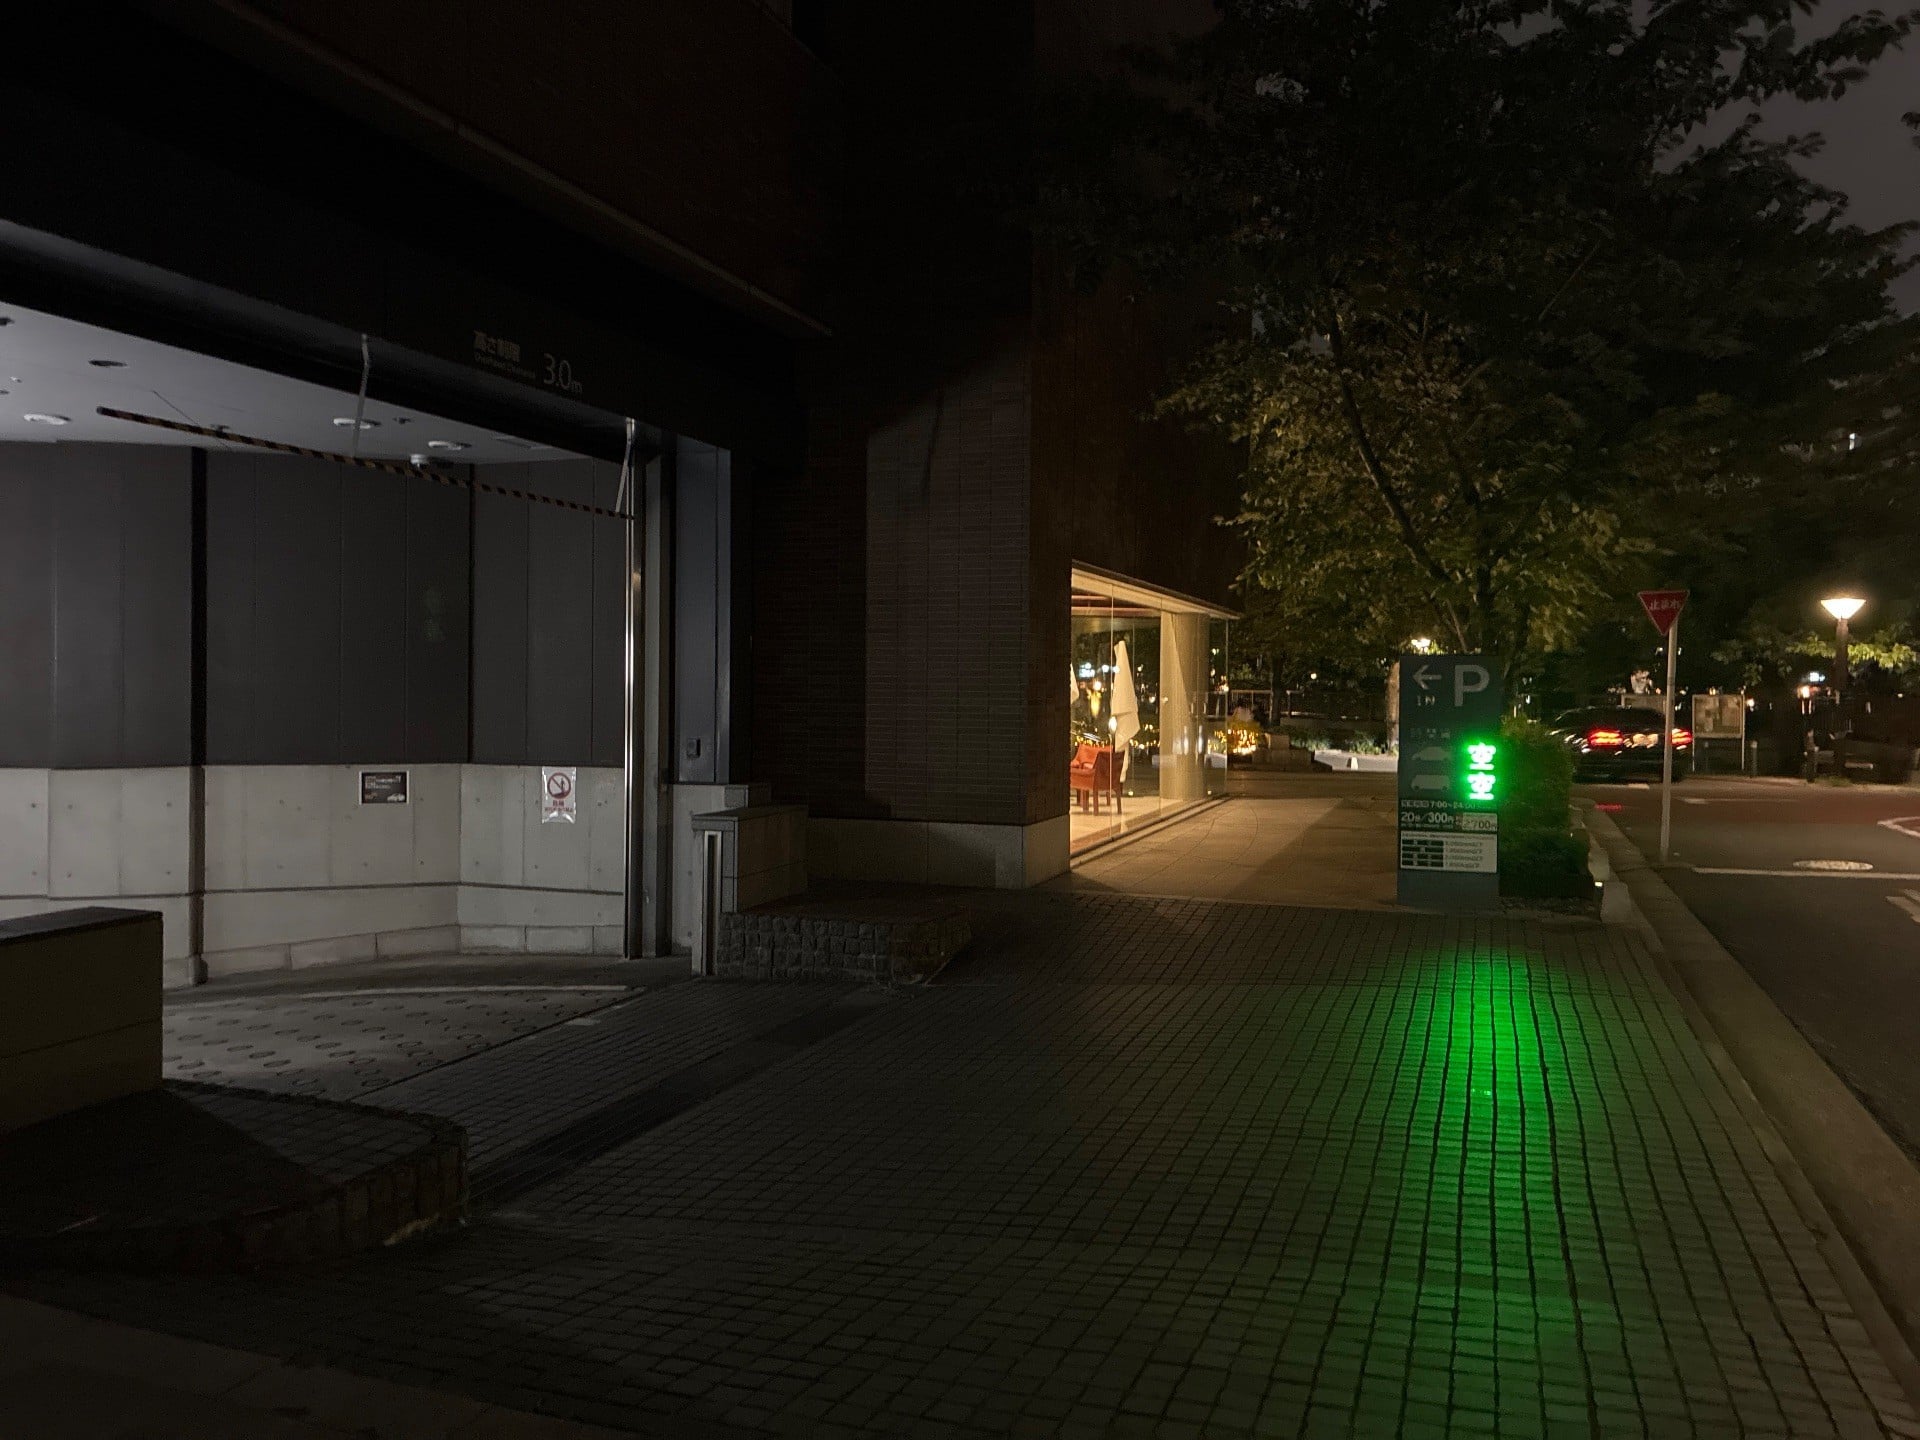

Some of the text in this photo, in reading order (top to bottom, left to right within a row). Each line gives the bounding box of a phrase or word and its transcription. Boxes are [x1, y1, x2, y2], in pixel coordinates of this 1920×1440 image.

[1650, 599, 1681, 611] 止まれ
[1455, 664, 1490, 707] P
[1467, 742, 1497, 770] 空
[1467, 771, 1496, 800] 空
